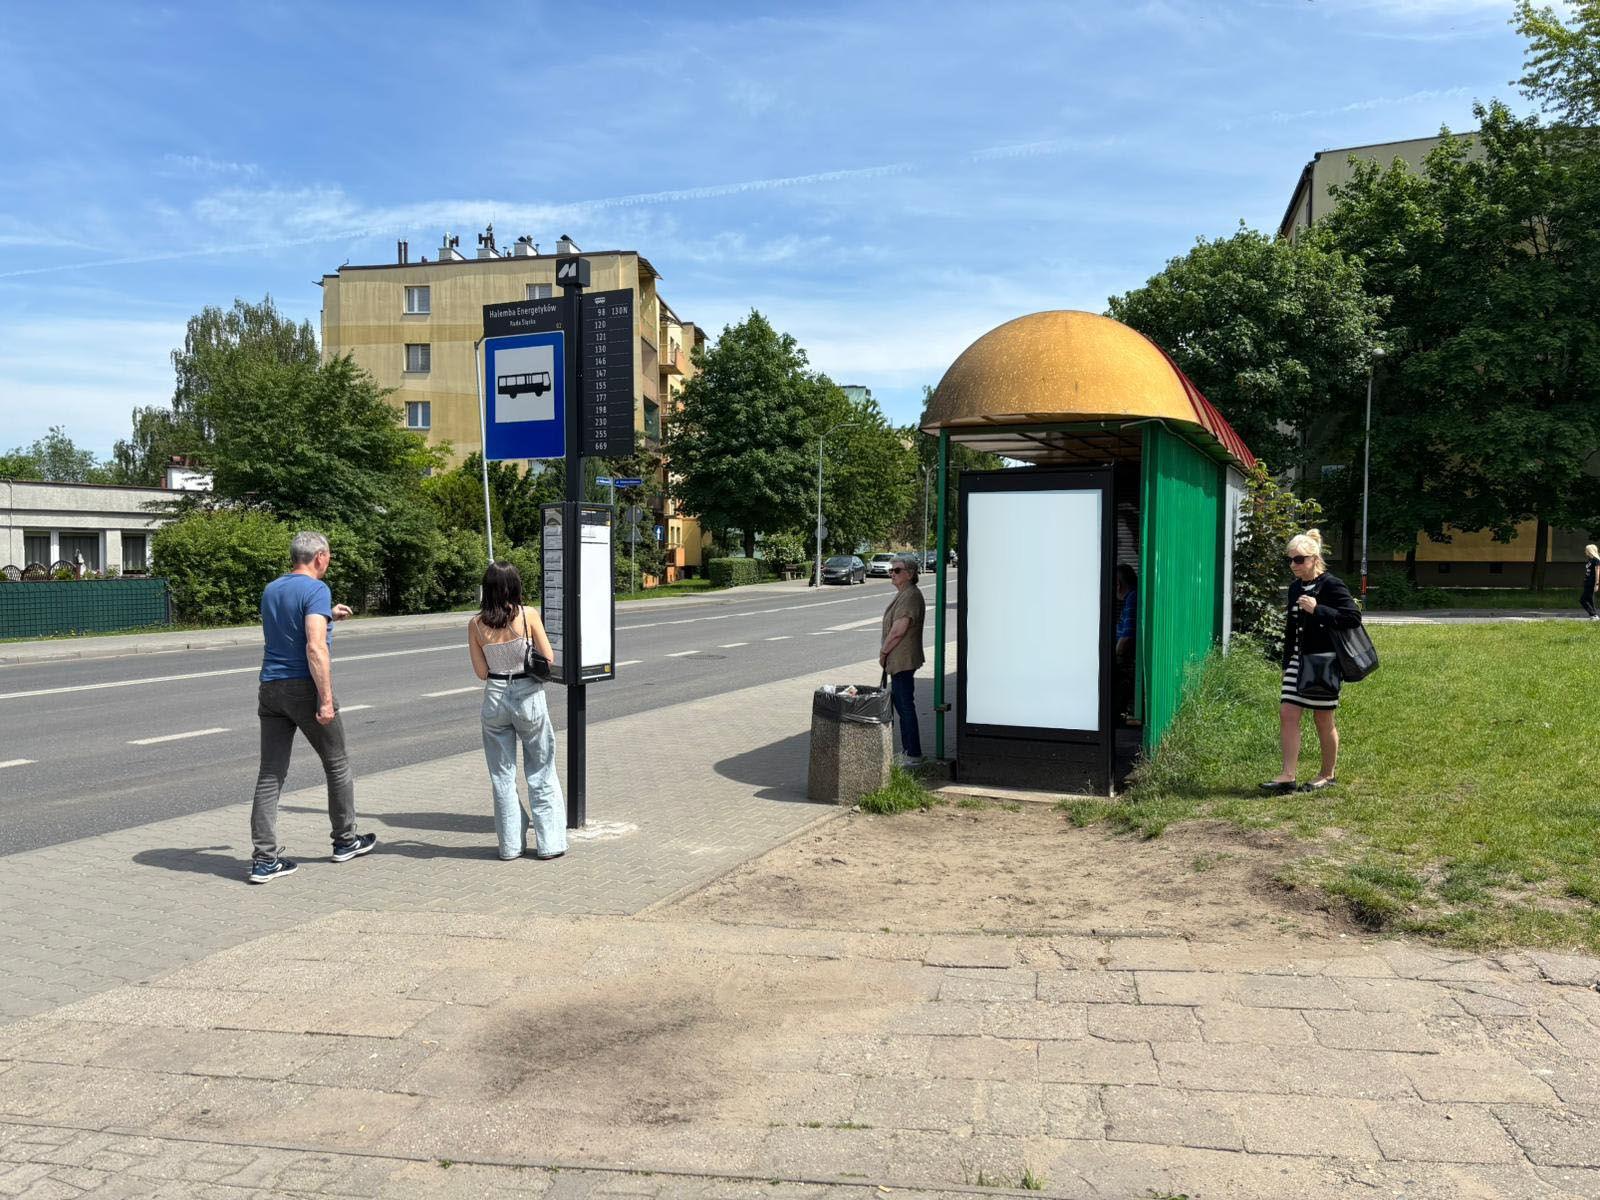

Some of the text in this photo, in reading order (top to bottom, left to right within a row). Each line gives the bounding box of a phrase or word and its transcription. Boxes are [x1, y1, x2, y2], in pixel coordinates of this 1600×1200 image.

[489, 303, 557, 318] Halemba Energetyków
[597, 306, 629, 317] 98 130N
[594, 320, 607, 330] 120
[595, 332, 607, 342] 121
[594, 345, 607, 354] 130
[595, 357, 607, 366] 146
[596, 369, 607, 378] 147
[595, 381, 607, 390] 155
[596, 393, 607, 402] 177
[595, 405, 607, 415] 198
[594, 417, 608, 427] 230
[594, 429, 608, 438] 255
[594, 441, 608, 451] 669
